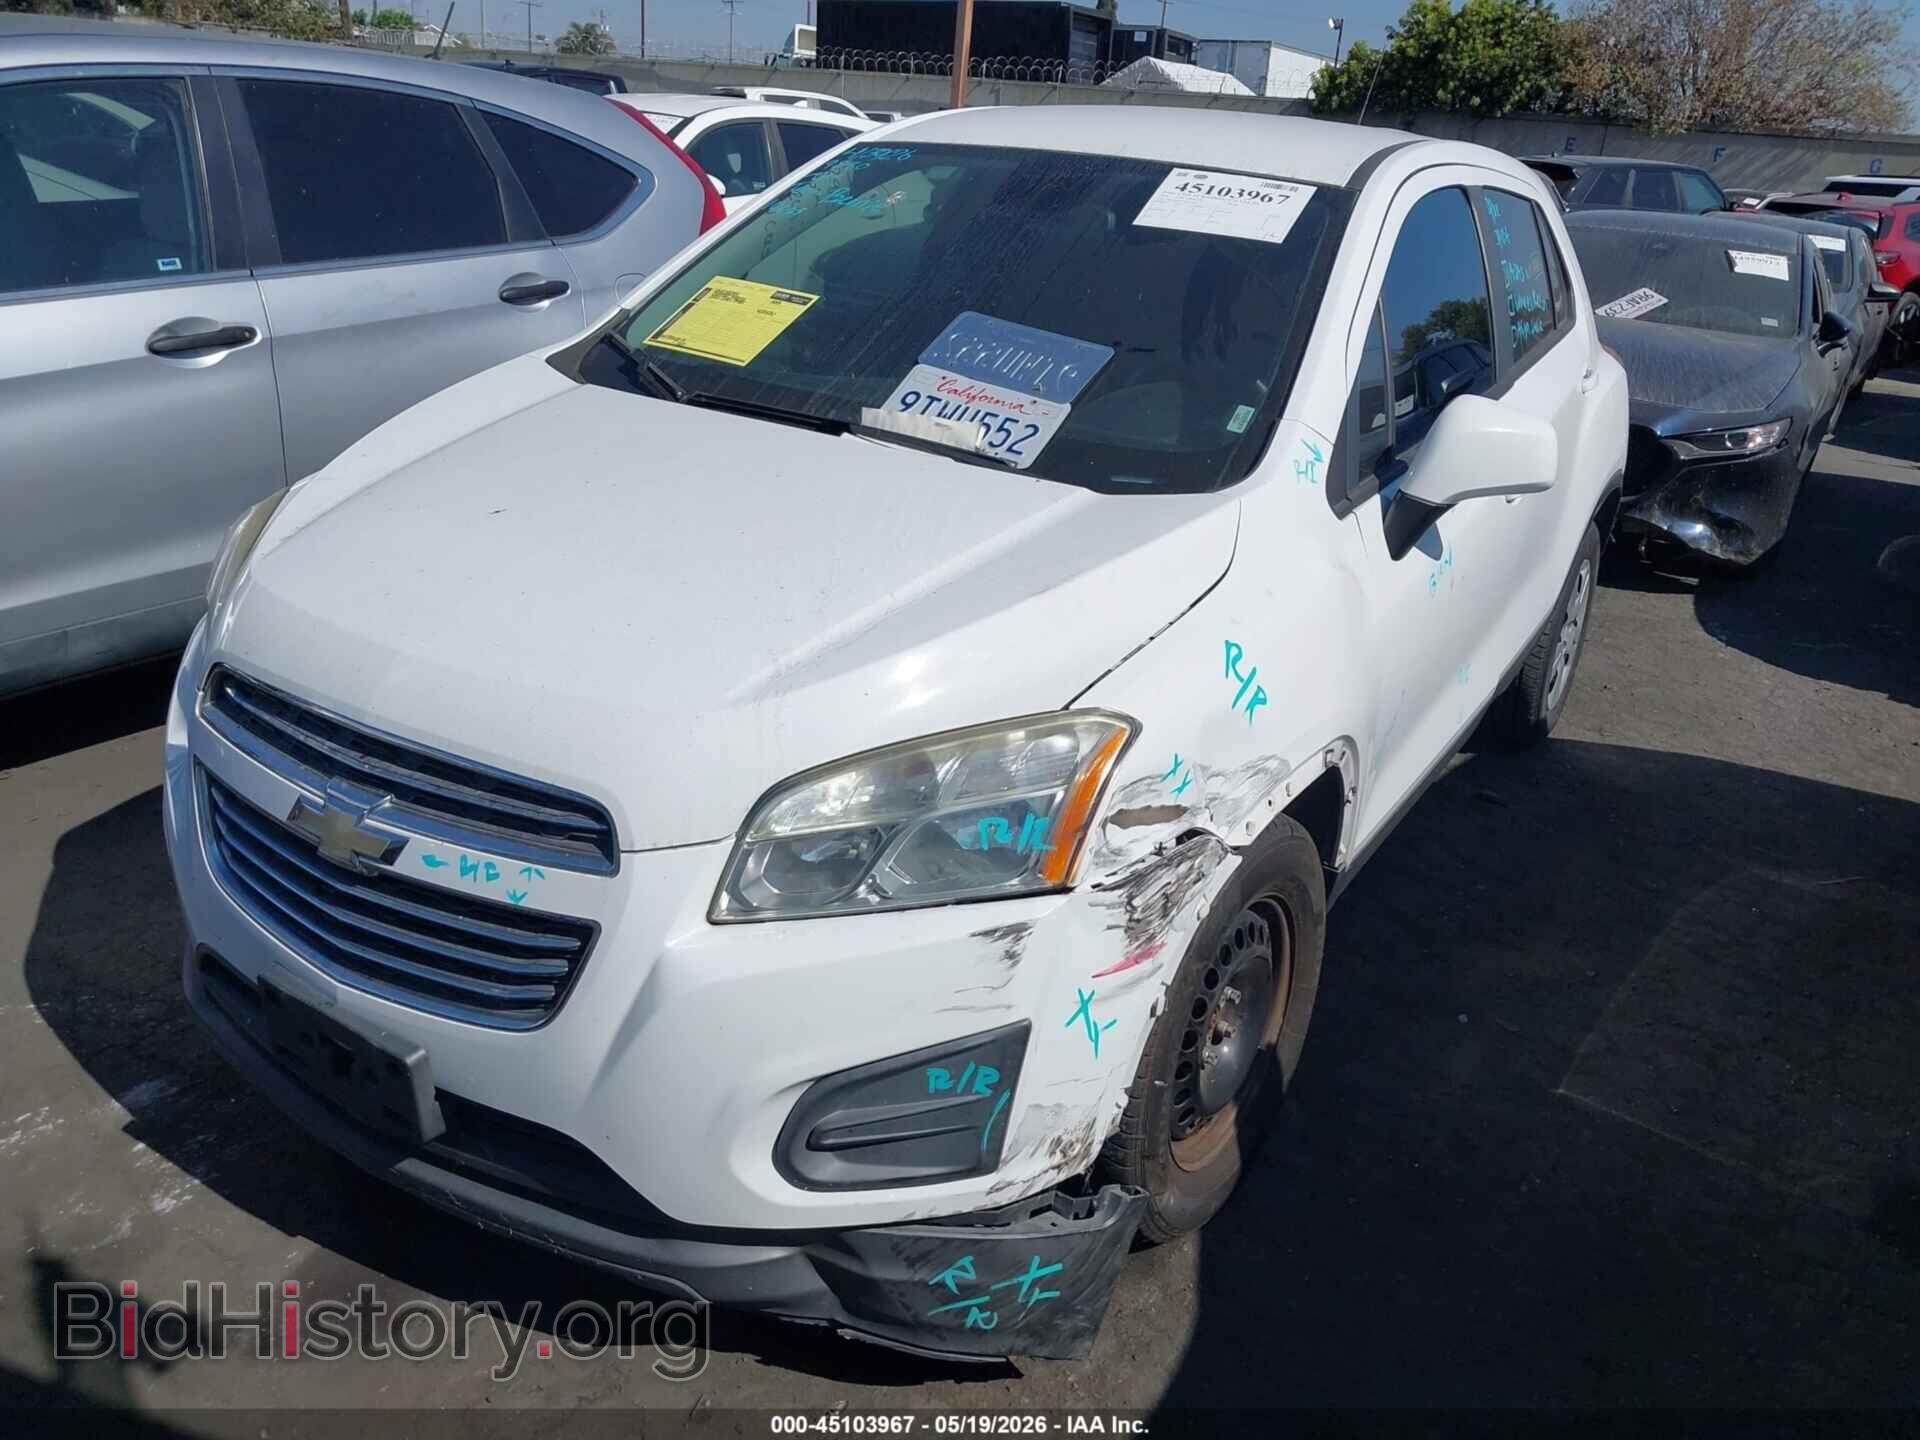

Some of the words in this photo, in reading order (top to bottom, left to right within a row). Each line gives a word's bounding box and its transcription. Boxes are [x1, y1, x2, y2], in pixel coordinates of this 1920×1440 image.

[1713, 147, 1726, 162] F
[1175, 181, 1290, 205] 45103967
[936, 377, 1032, 415] California
[1225, 639, 1267, 726] R/R
[926, 1060, 1000, 1096] R/R
